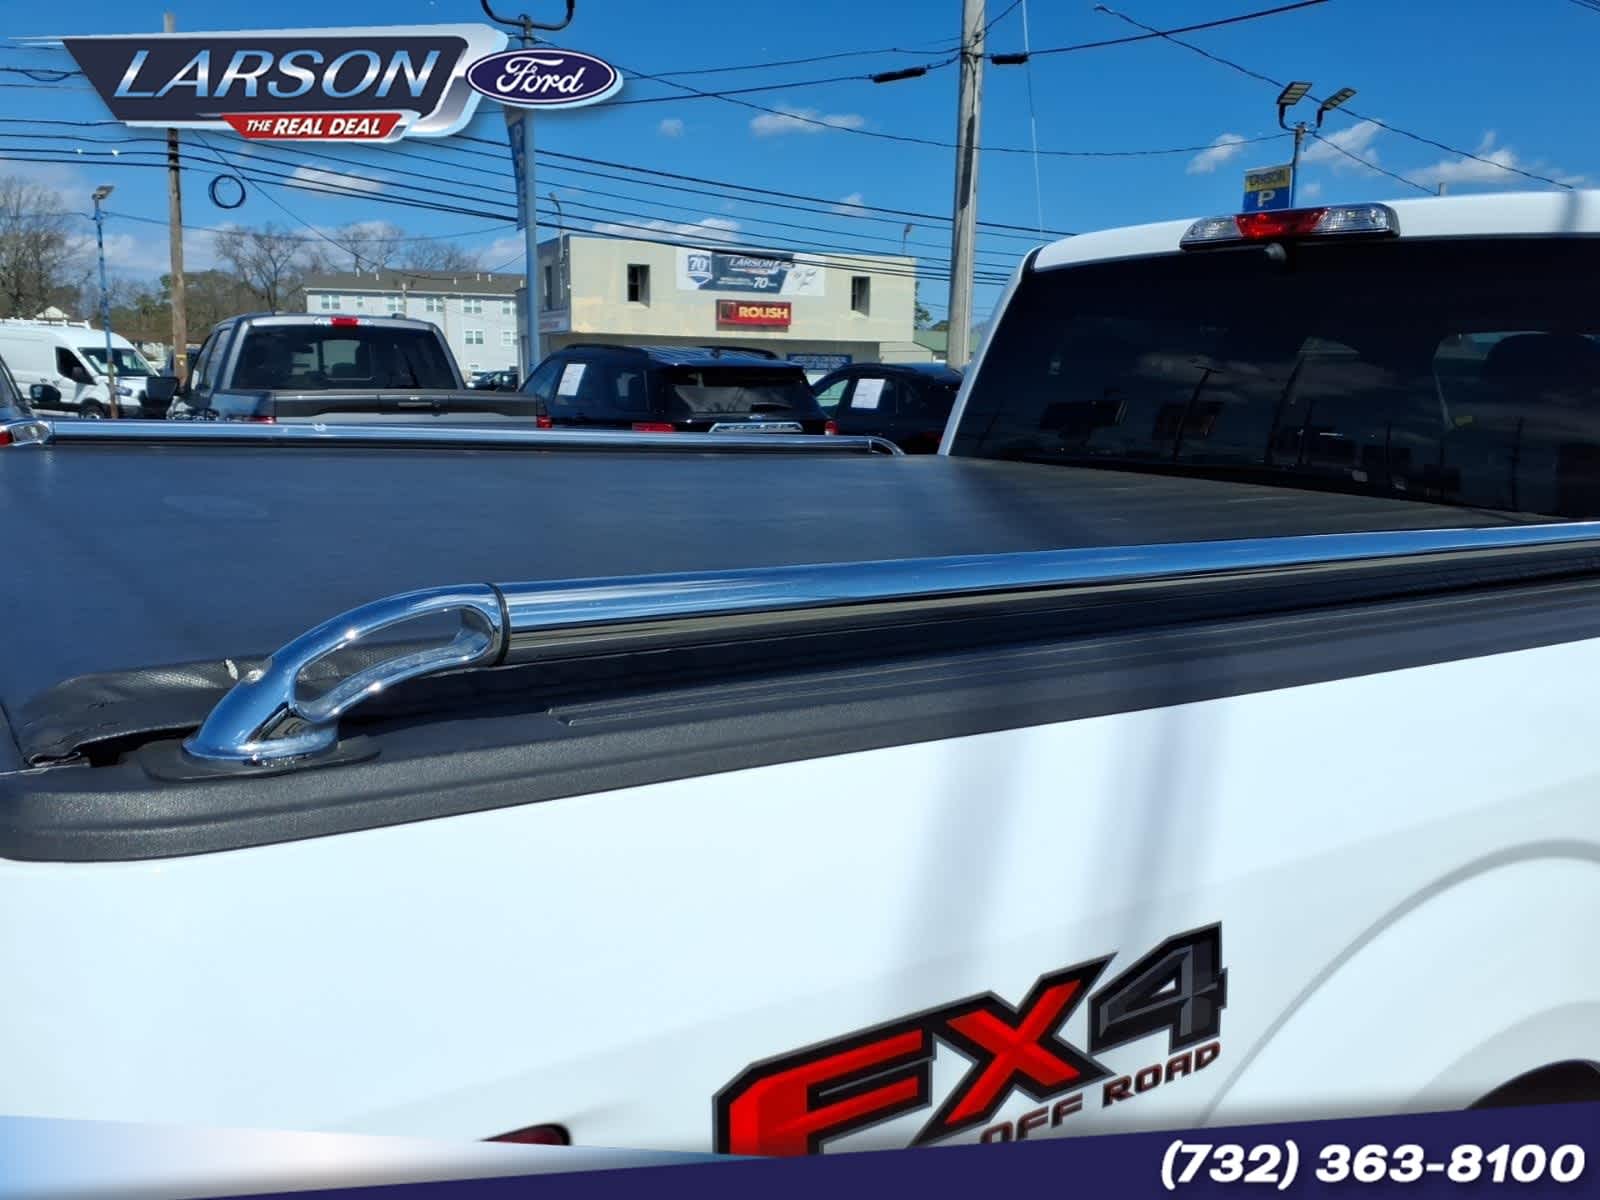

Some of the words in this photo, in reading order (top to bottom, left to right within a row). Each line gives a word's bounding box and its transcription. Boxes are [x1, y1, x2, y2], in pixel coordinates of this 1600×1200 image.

[738, 306, 788, 319] ROUSH
[712, 921, 1227, 1155] FX4
[1101, 1041, 1221, 1108] ROAD
